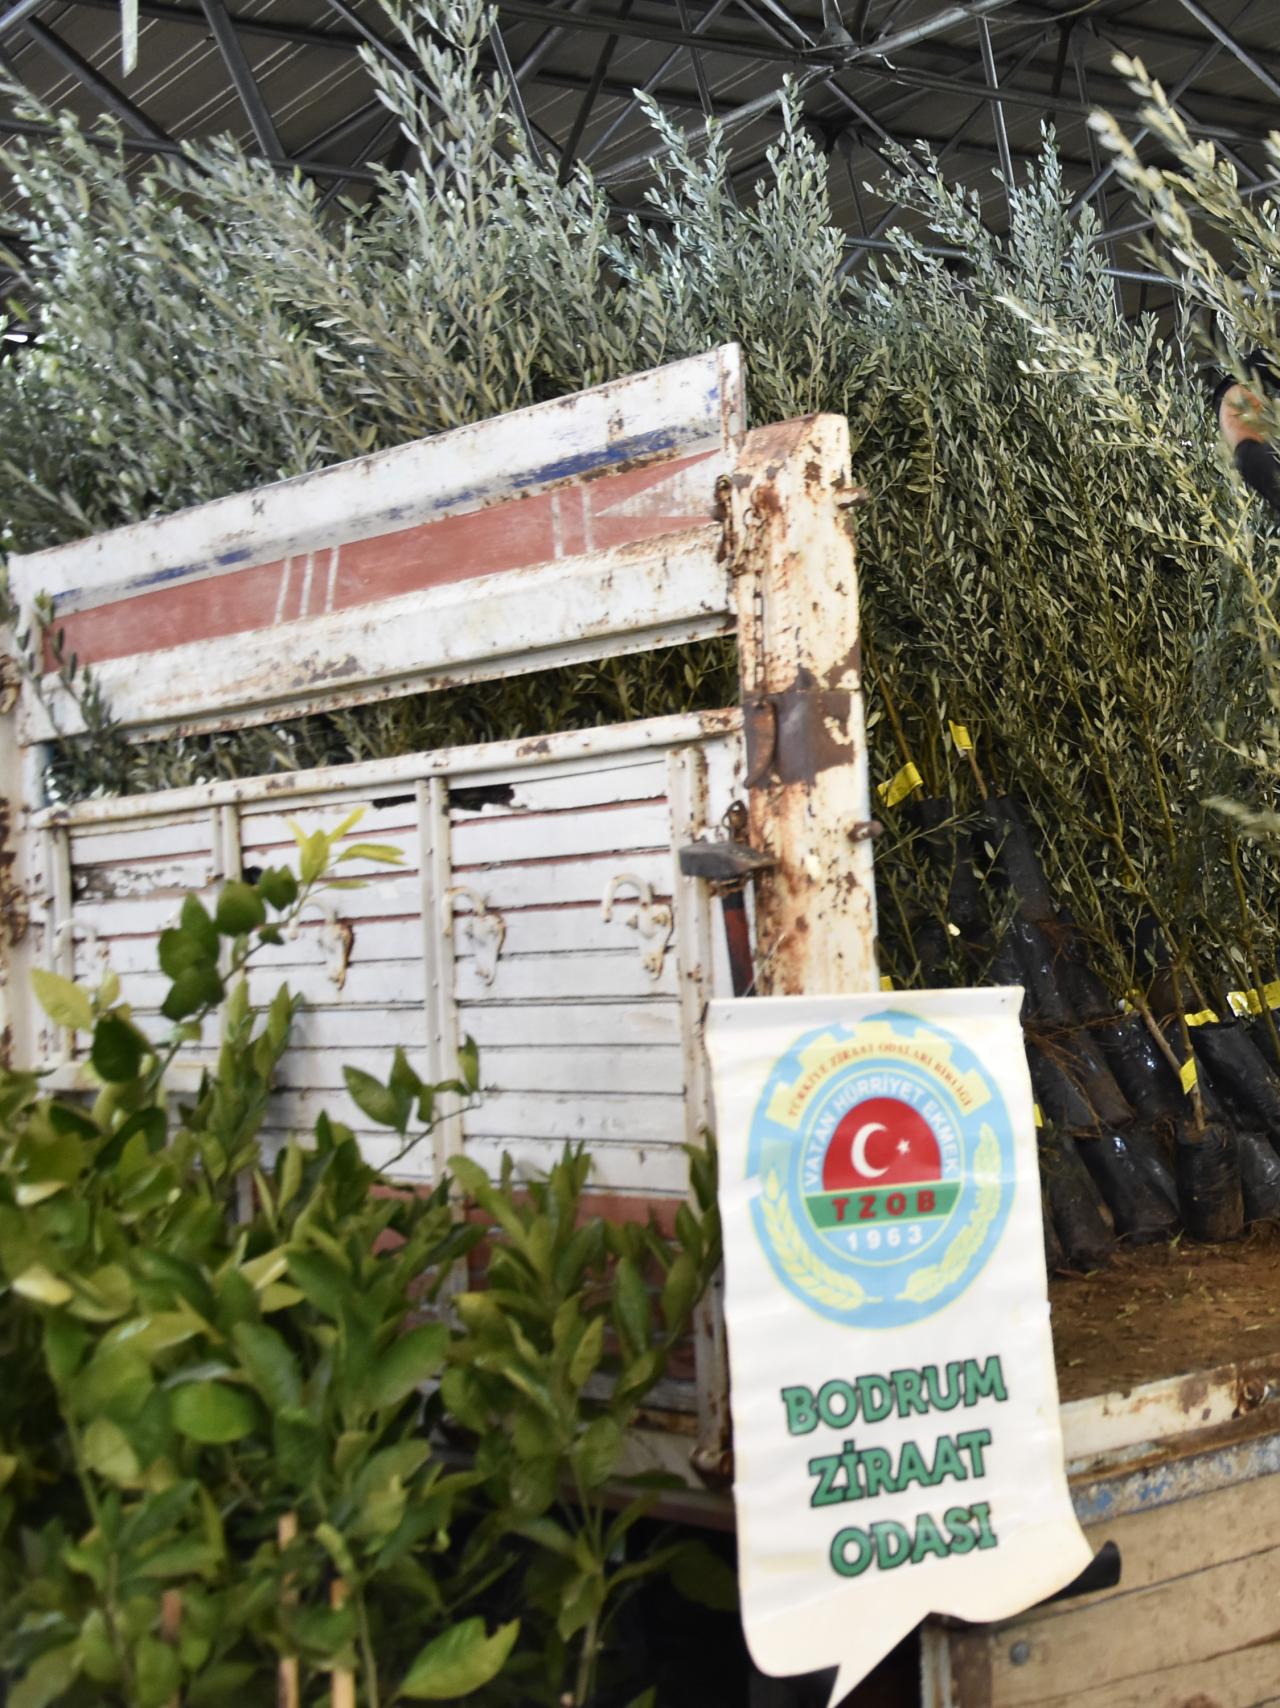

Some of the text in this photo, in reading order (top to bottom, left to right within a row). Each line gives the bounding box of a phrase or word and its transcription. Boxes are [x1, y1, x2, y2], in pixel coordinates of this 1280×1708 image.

[804, 1110, 836, 1187] VATAN
[922, 1100, 960, 1173] EKMEK
[832, 1189, 936, 1222] TZOB
[846, 1225, 923, 1252] 1963
[781, 1355, 1009, 1436] BODRUM
[808, 1429, 993, 1508] ZİRAAT
[829, 1502, 998, 1578] ODASI
